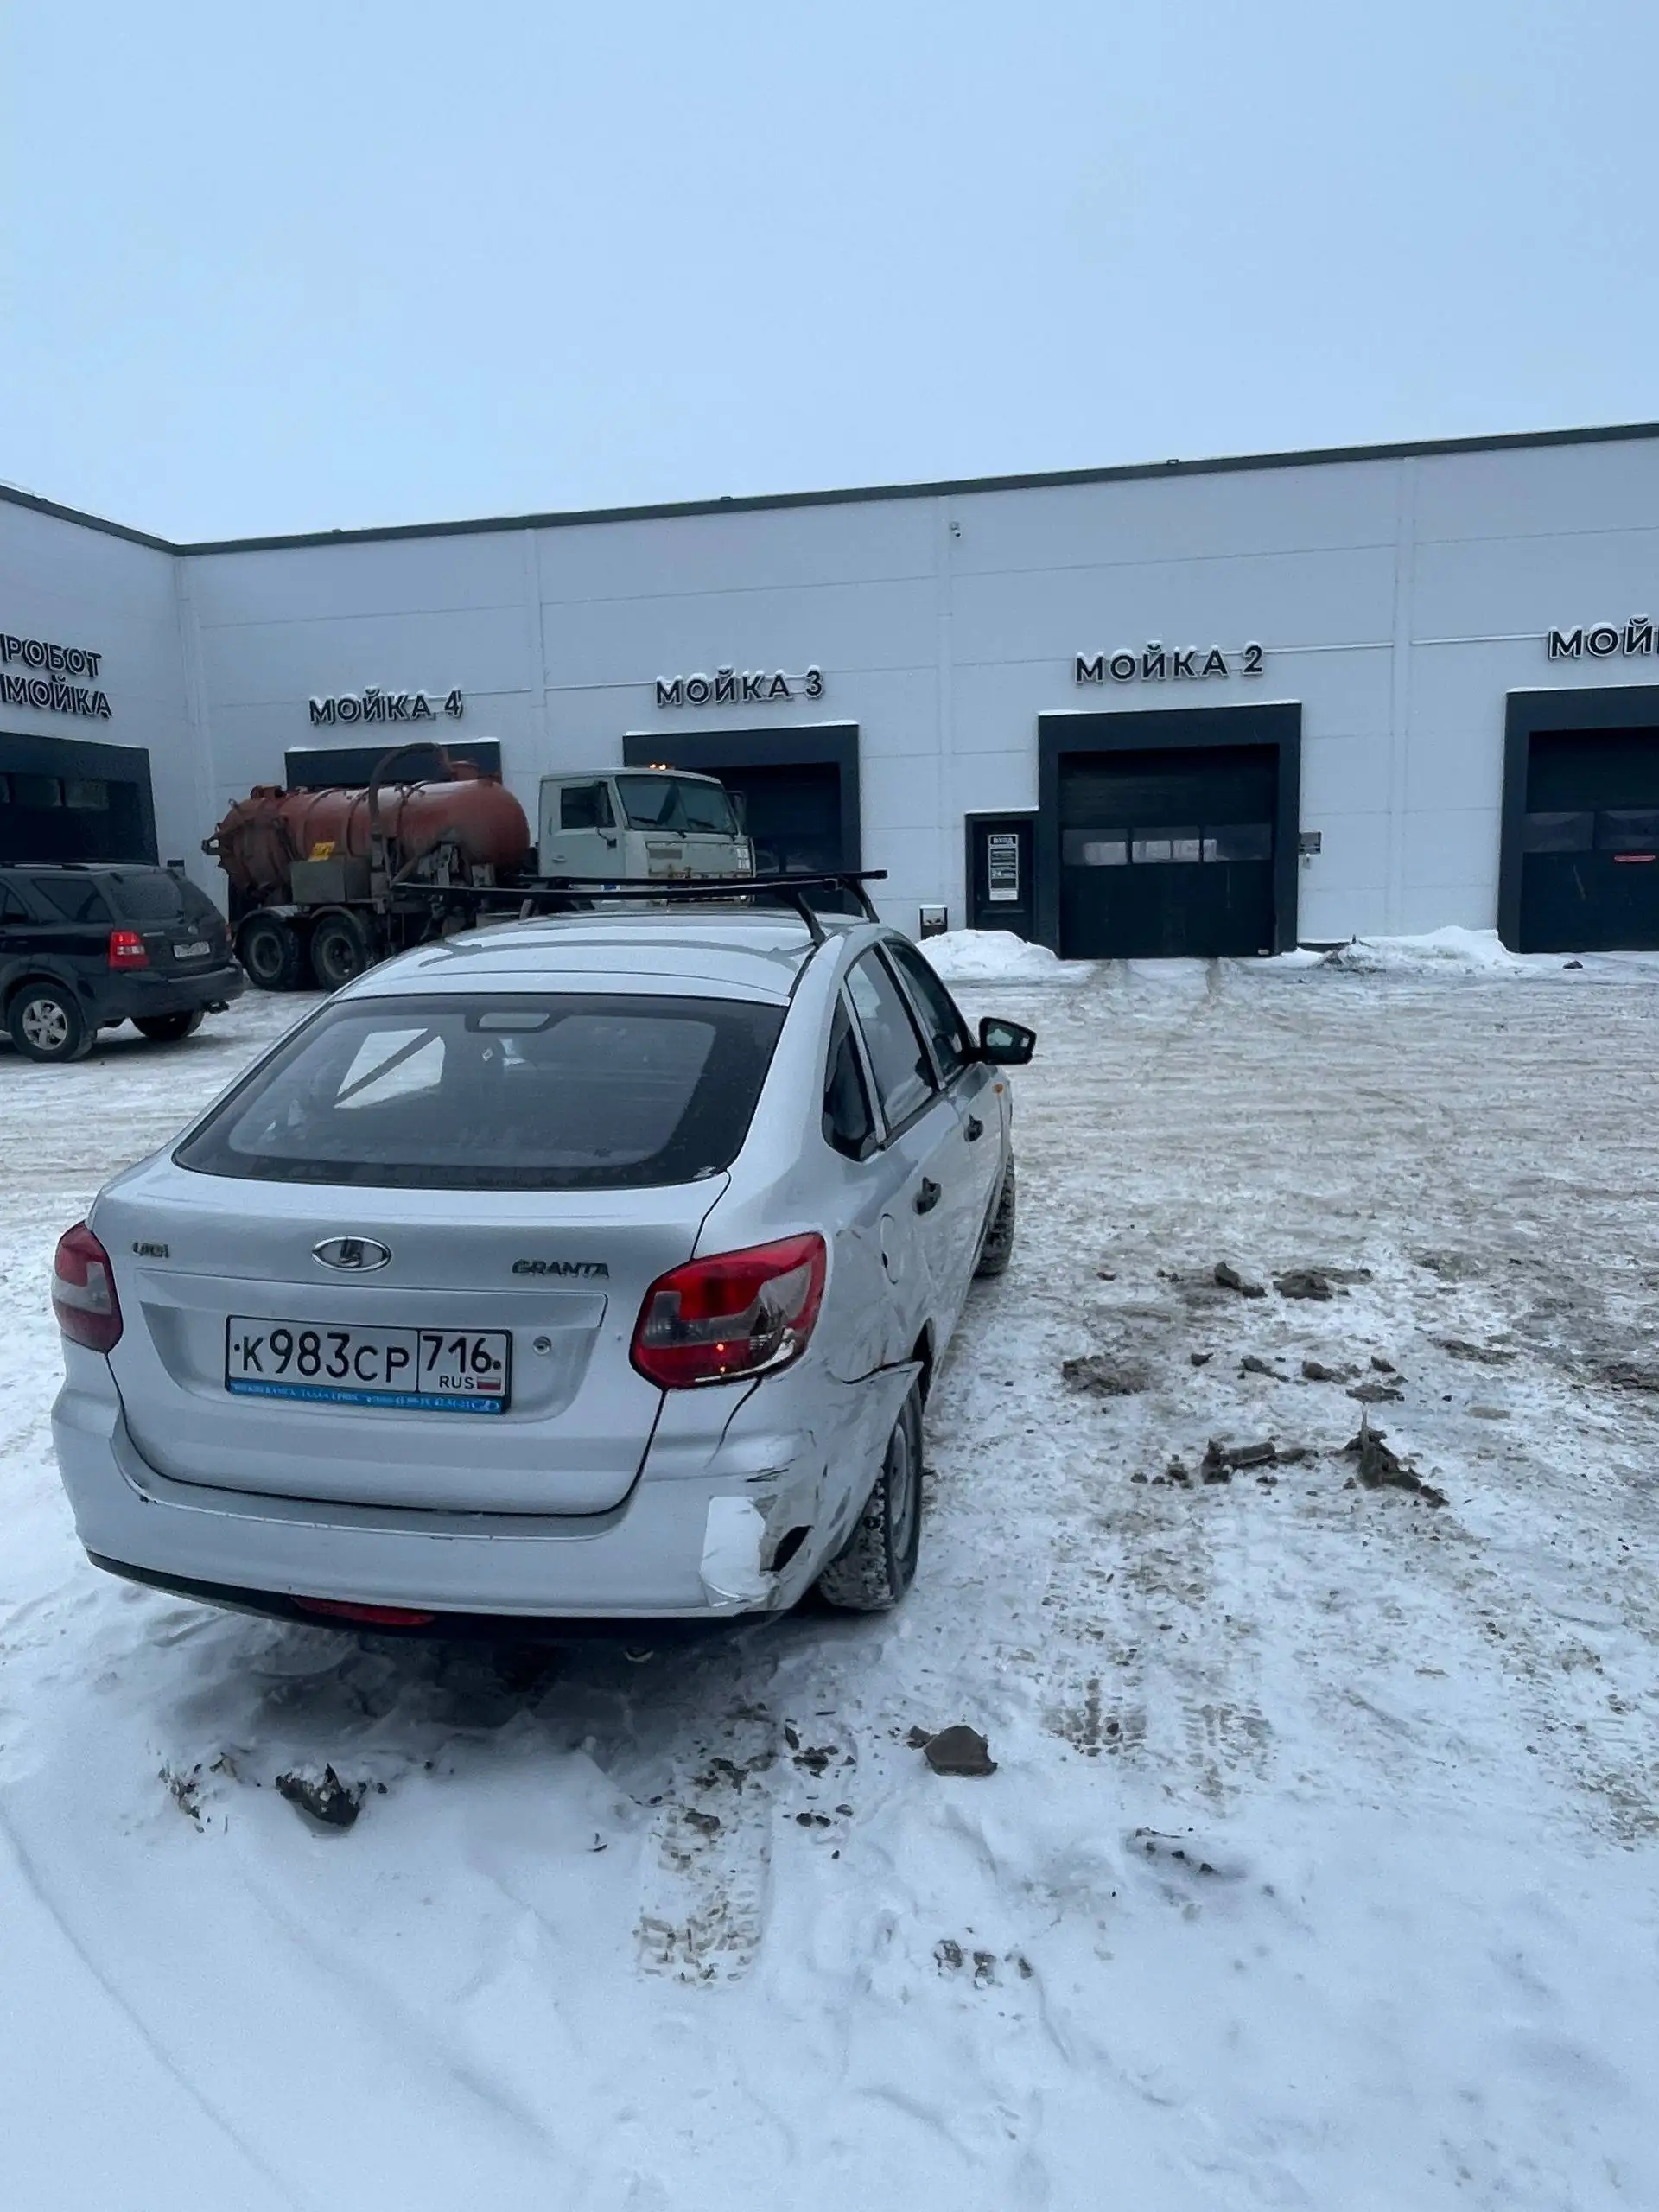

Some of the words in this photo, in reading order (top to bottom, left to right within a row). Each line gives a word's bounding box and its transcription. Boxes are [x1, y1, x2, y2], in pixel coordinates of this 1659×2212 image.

[0, 632, 103, 677] РОБОТ
[1548, 614, 1659, 660] МОЙ
[1076, 641, 1230, 683] МОЙКА
[1243, 643, 1263, 674] 2
[0, 673, 112, 719] МОЙКА
[309, 688, 435, 725] МОЙКА
[444, 690, 463, 718] 4
[656, 666, 793, 707] МОЙКА
[805, 668, 823, 698] 3
[512, 1259, 609, 1278] GRANTA
[422, 1335, 492, 1374] 716
[439, 1375, 474, 1390] RUS
